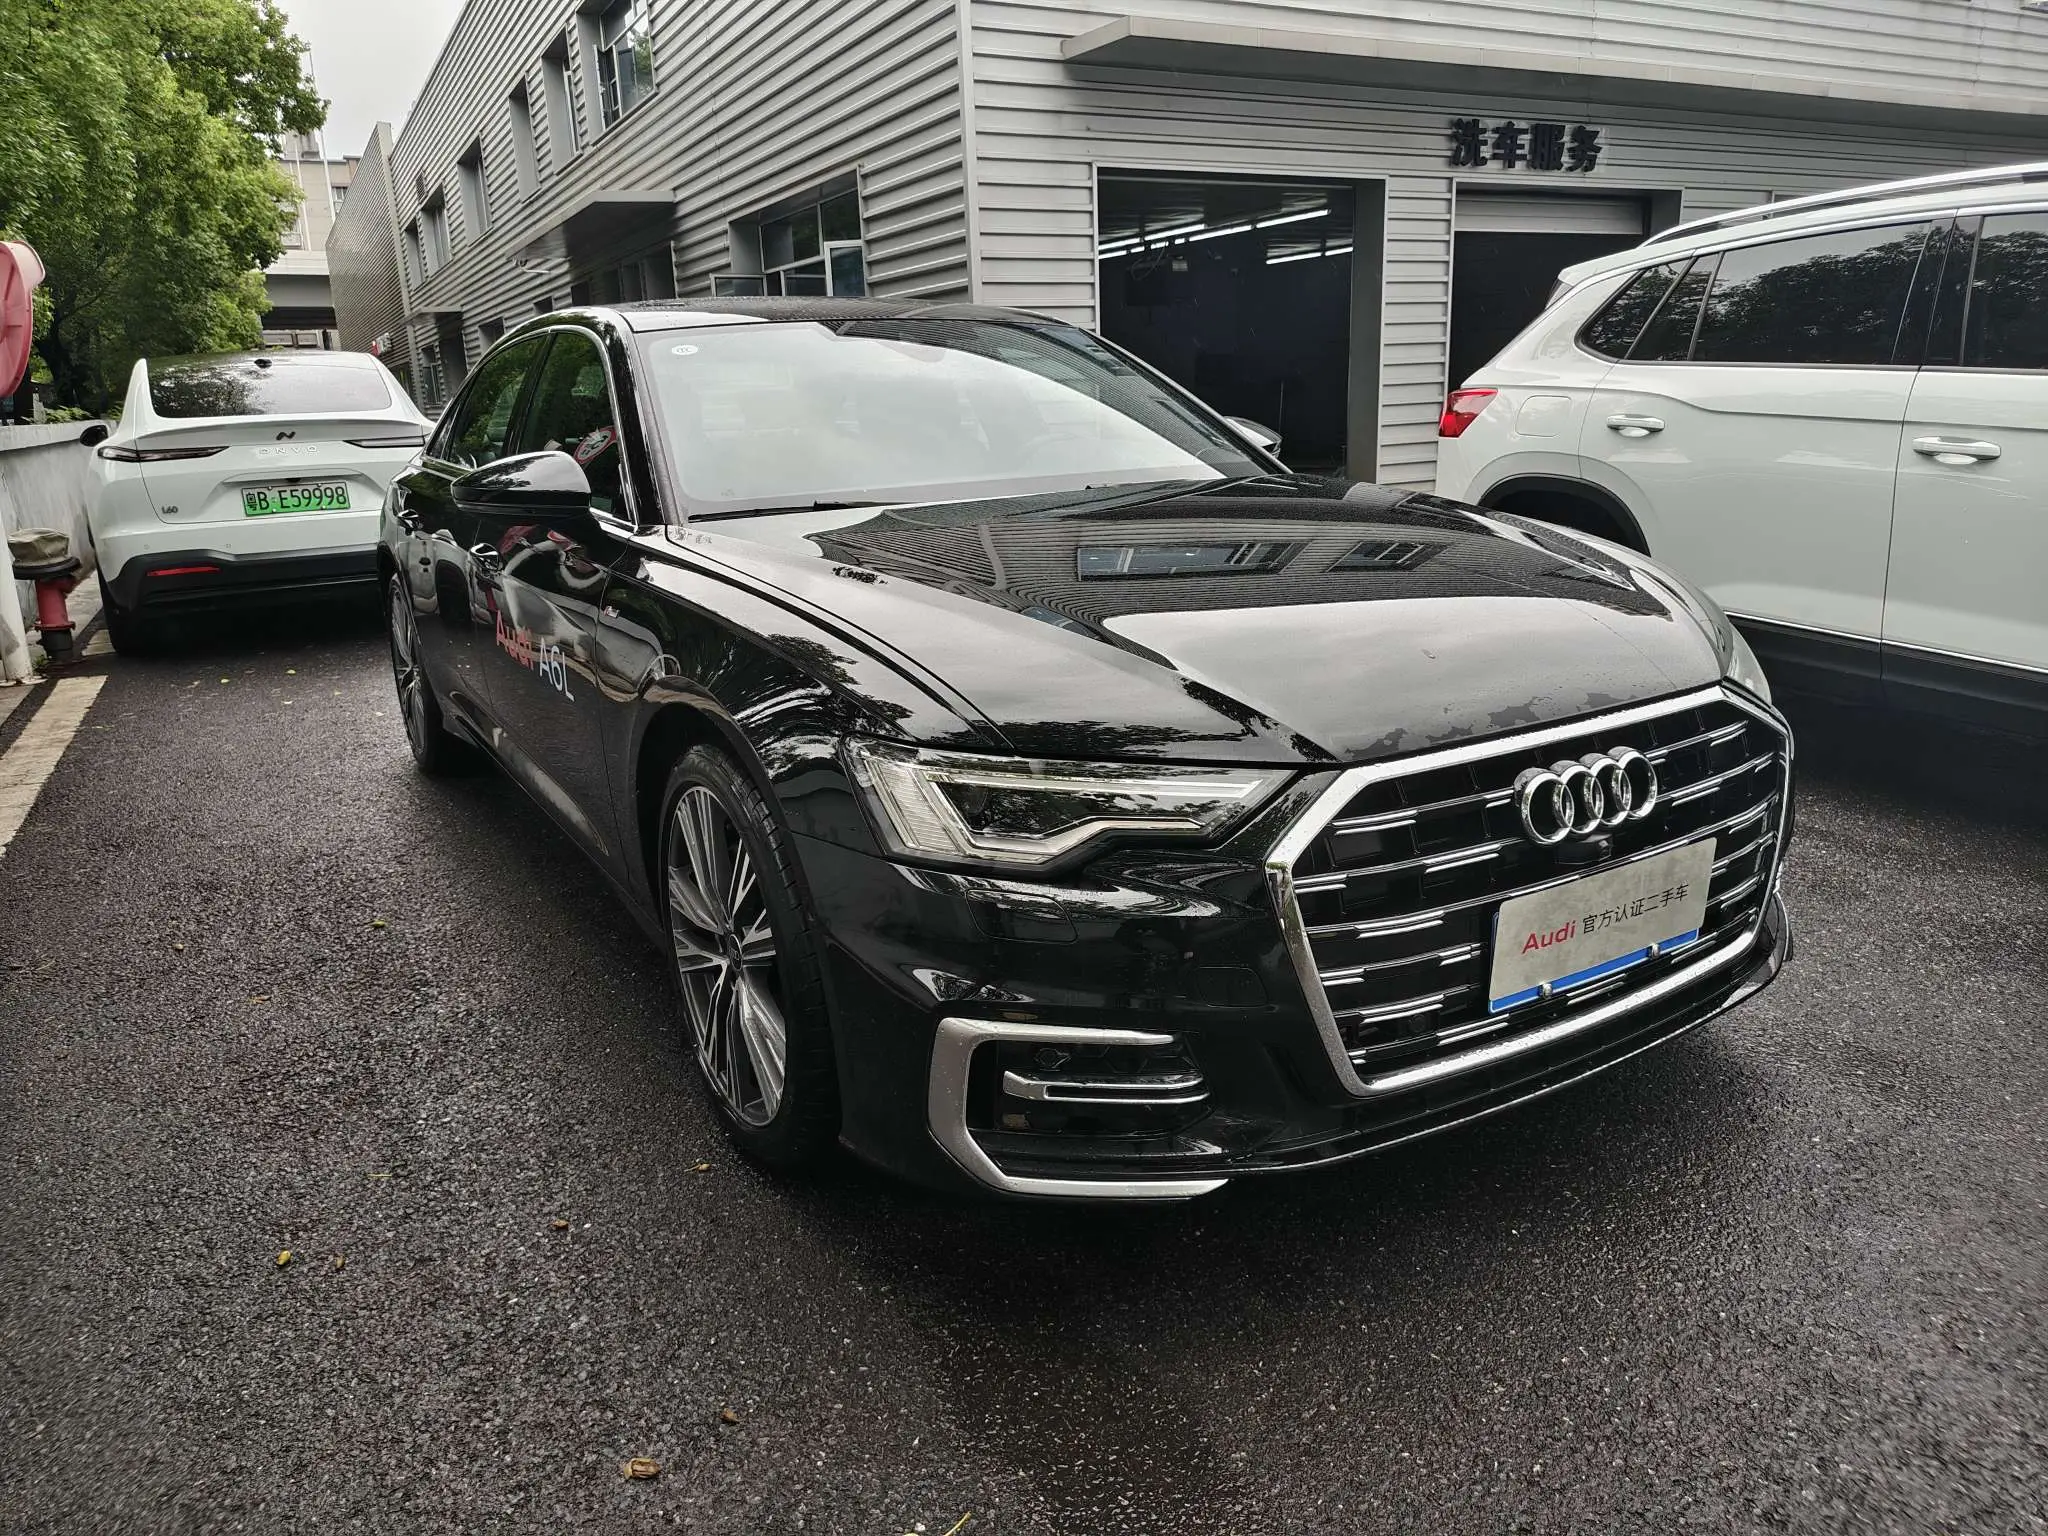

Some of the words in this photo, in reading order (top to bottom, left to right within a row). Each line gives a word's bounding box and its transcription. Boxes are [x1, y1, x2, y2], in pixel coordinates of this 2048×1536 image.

[1451, 118, 1602, 172] 洗车服务
[539, 636, 575, 702] A6L
[1522, 920, 1576, 954] Audi
[1582, 884, 1689, 934] 官方认证二手车
